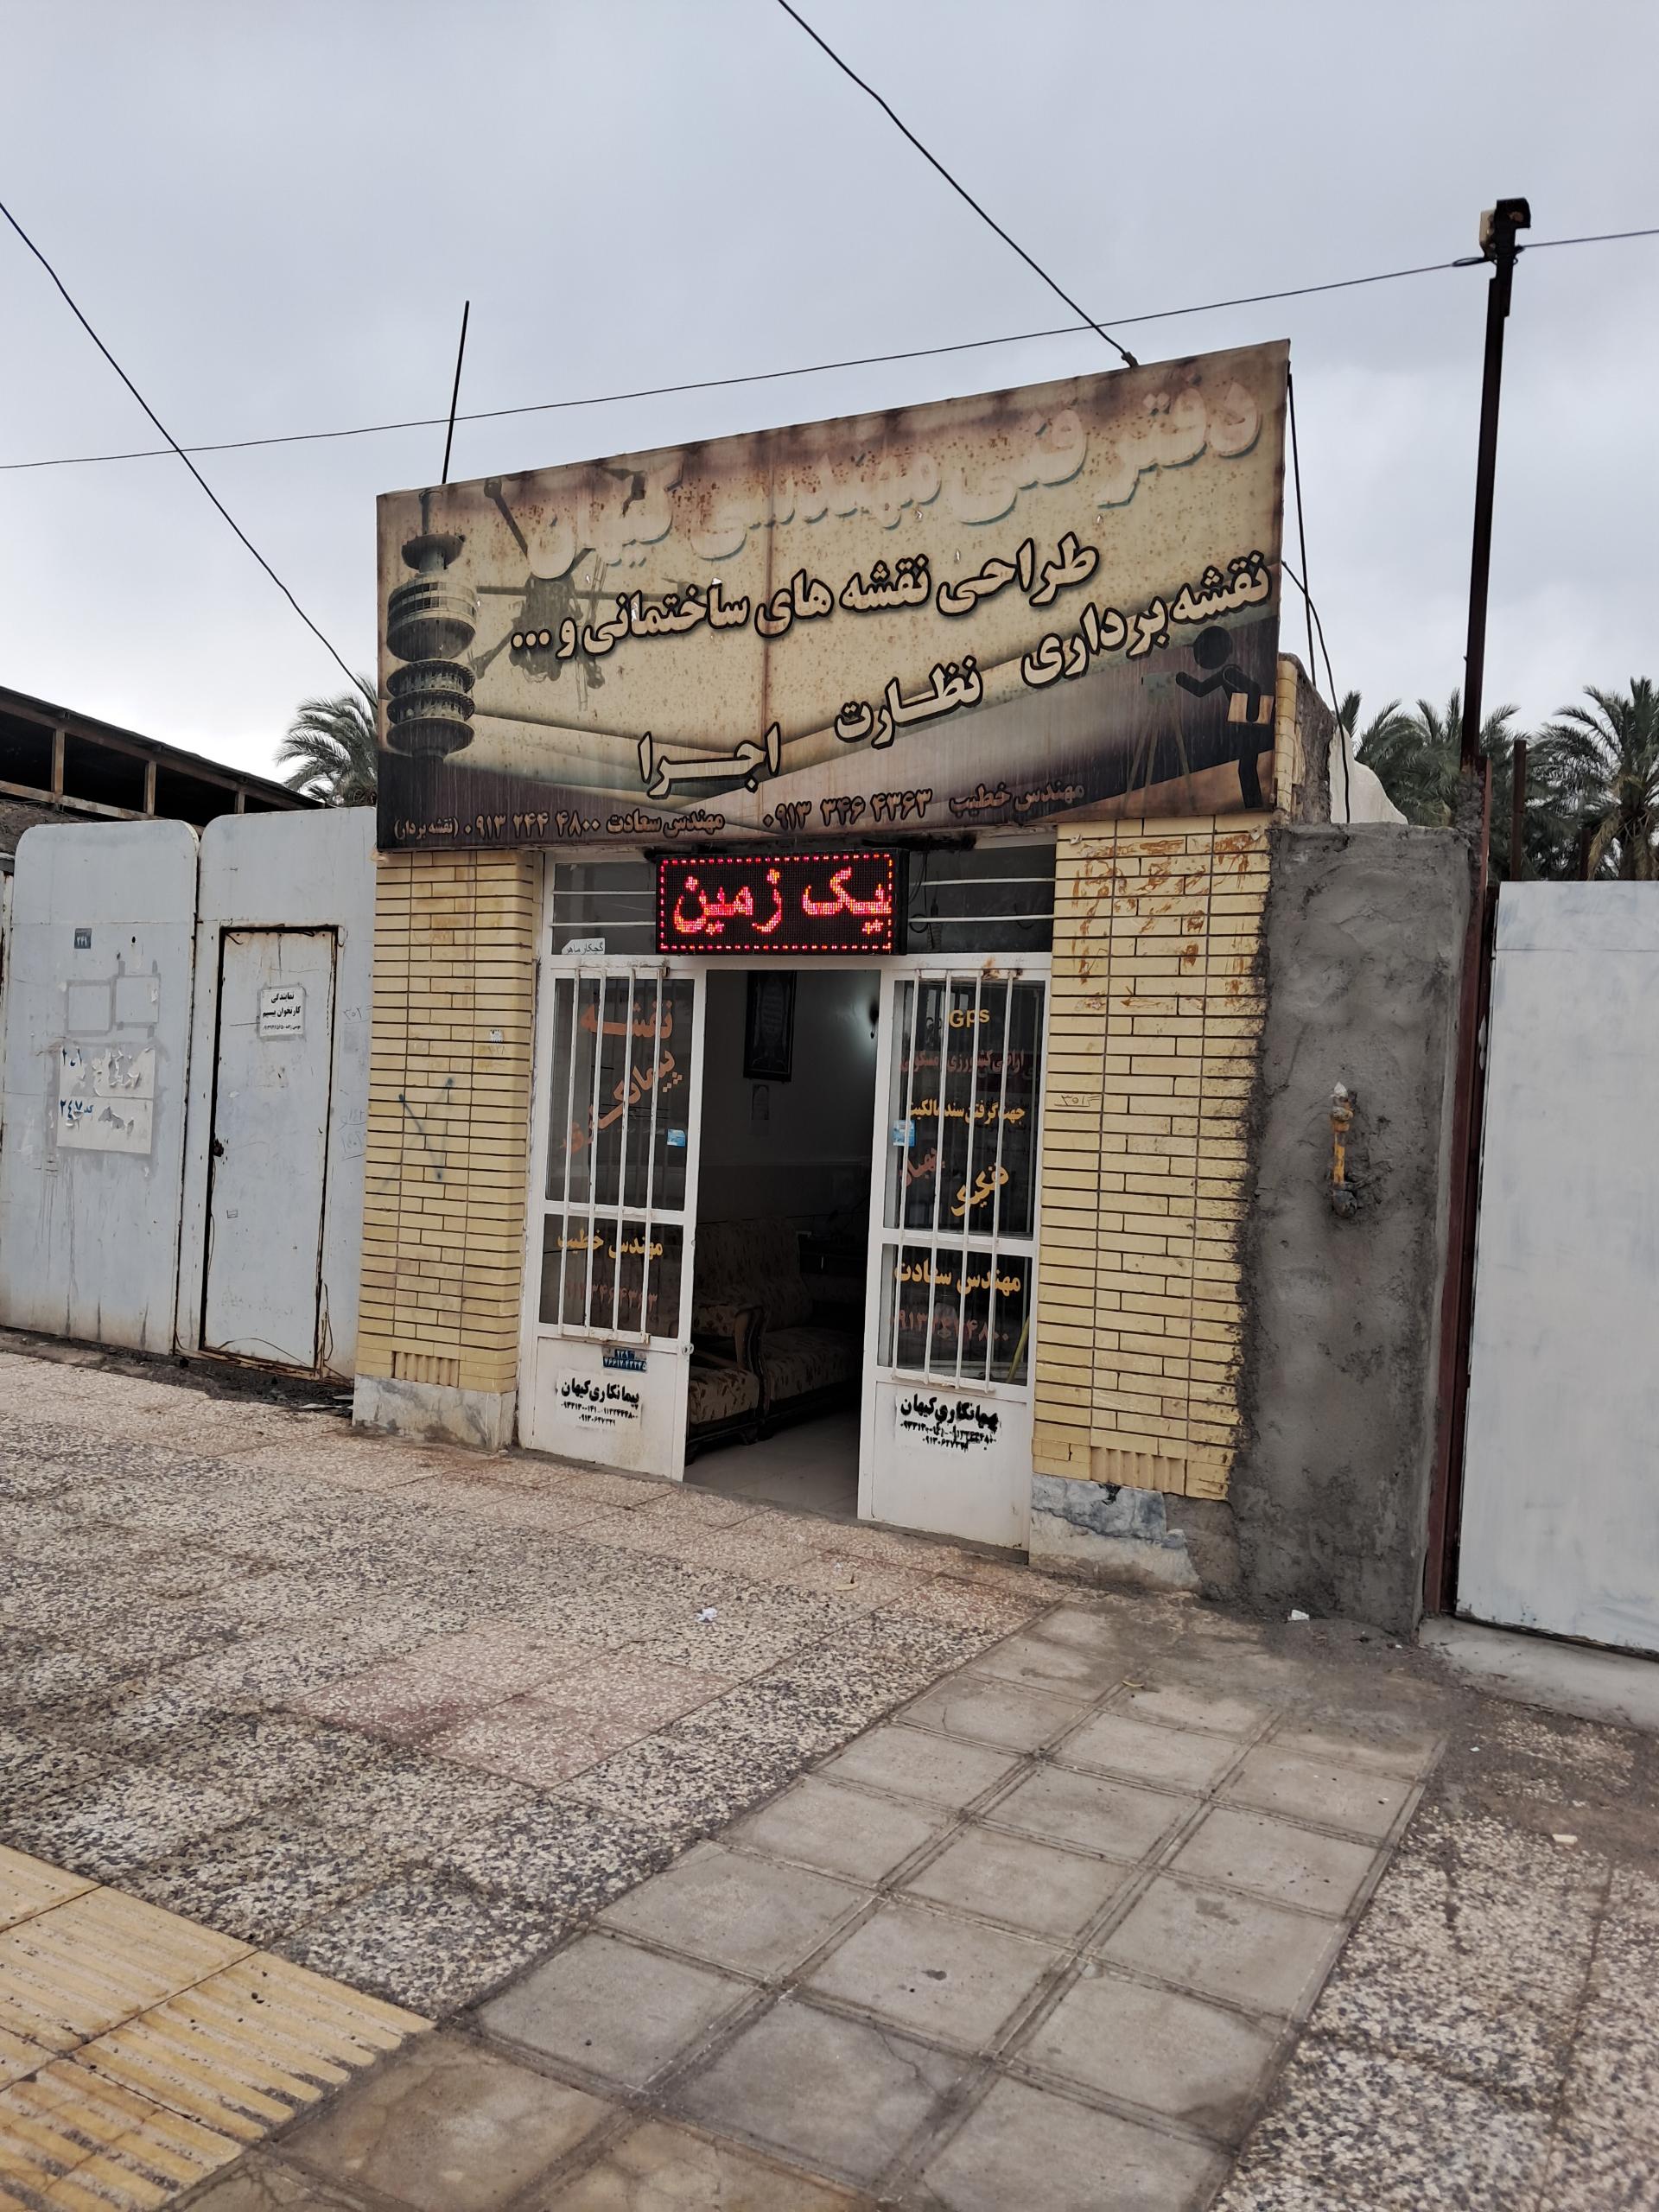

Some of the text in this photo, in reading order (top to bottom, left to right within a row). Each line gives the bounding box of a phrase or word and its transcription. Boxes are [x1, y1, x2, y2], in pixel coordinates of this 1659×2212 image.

[526, 373, 1263, 580] دفتر فنی مهندسی کیهان
[839, 553, 931, 612] نقشه
[936, 531, 1101, 618] طراحی
[582, 581, 751, 657] ساختمانی
[753, 568, 835, 639] های
[1020, 550, 1273, 689] نقشه برداری
[556, 617, 577, 660] و
[833, 655, 984, 749] نظارت
[636, 720, 782, 800] اجرا
[949, 782, 1012, 818] خطیب
[1014, 779, 1085, 813] مهندس
[606, 808, 662, 835] سعادت
[663, 809, 726, 838] مهندس
[673, 868, 783, 935] زمین
[580, 1000, 673, 1039] نقشه
[950, 1008, 989, 1027] Gps
[900, 1051, 938, 1072] مسکوی
[947, 1049, 993, 1072] کشورزی
[908, 1099, 944, 1120] الکیت
[950, 1162, 1009, 1217] تفکیک
[557, 1228, 663, 1261] مهندس خطیب
[893, 1258, 1021, 1296] مهندس سعادت
[561, 1377, 639, 1410] پیمانکاری کیهان
[900, 1393, 937, 1417] کیهان
